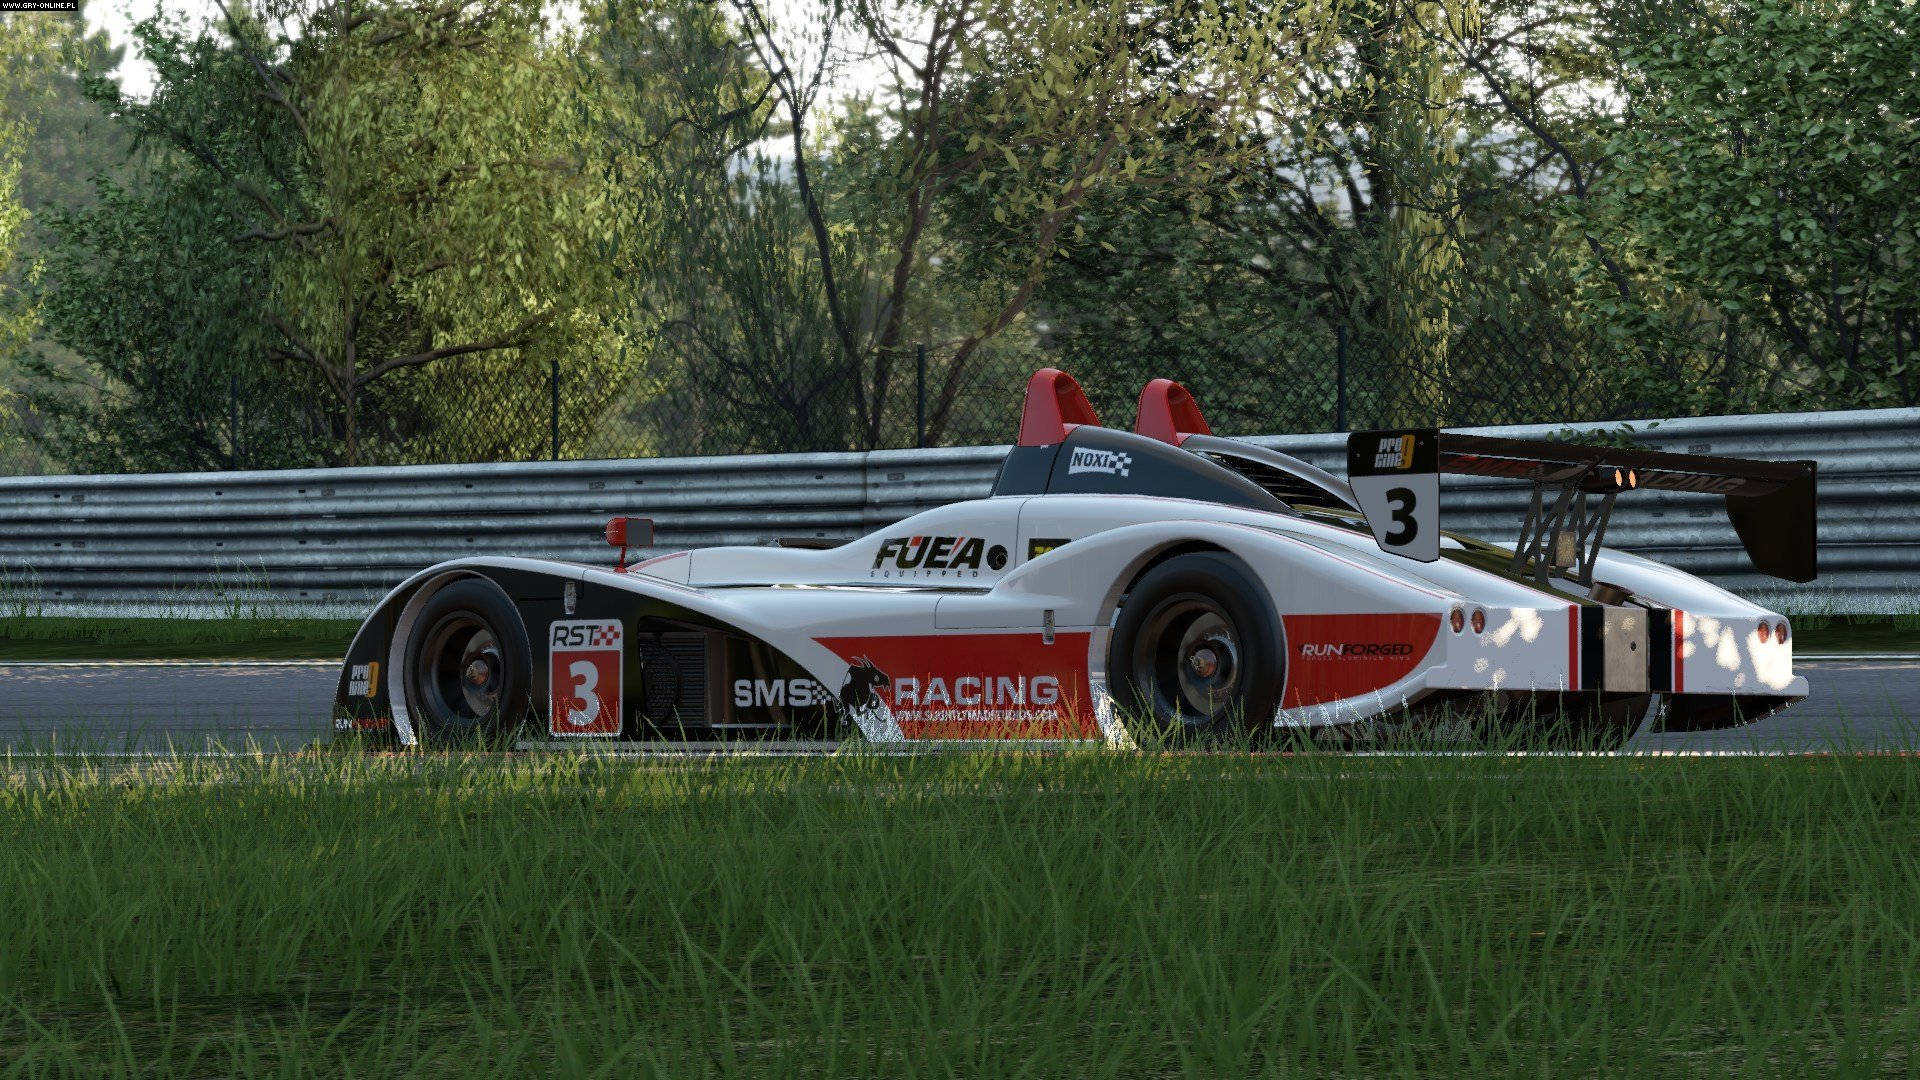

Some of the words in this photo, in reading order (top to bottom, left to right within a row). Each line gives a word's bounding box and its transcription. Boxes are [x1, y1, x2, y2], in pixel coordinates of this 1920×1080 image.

[1072, 452, 1110, 468] NOXI
[1384, 487, 1419, 546] 3
[552, 625, 600, 646] RST
[567, 660, 600, 726] 3
[734, 678, 814, 708] SMS
[894, 675, 1059, 706] RACING
